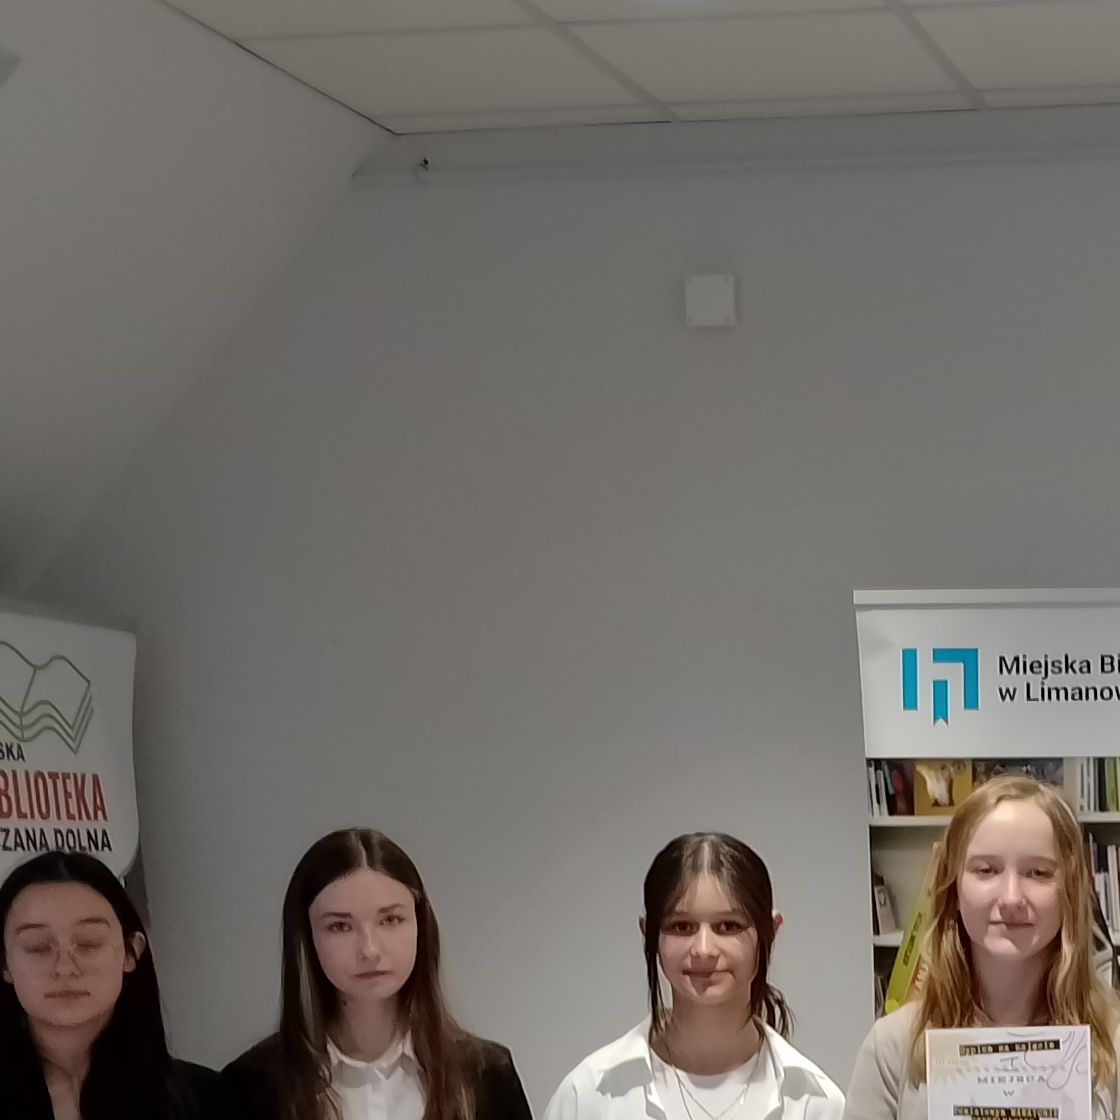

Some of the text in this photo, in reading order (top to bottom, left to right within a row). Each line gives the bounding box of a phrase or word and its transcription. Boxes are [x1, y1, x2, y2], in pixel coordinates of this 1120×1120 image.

[999, 654, 1091, 678] Miejska
[998, 686, 1015, 702] w
[0, 828, 113, 852] ZANA DOLNA
